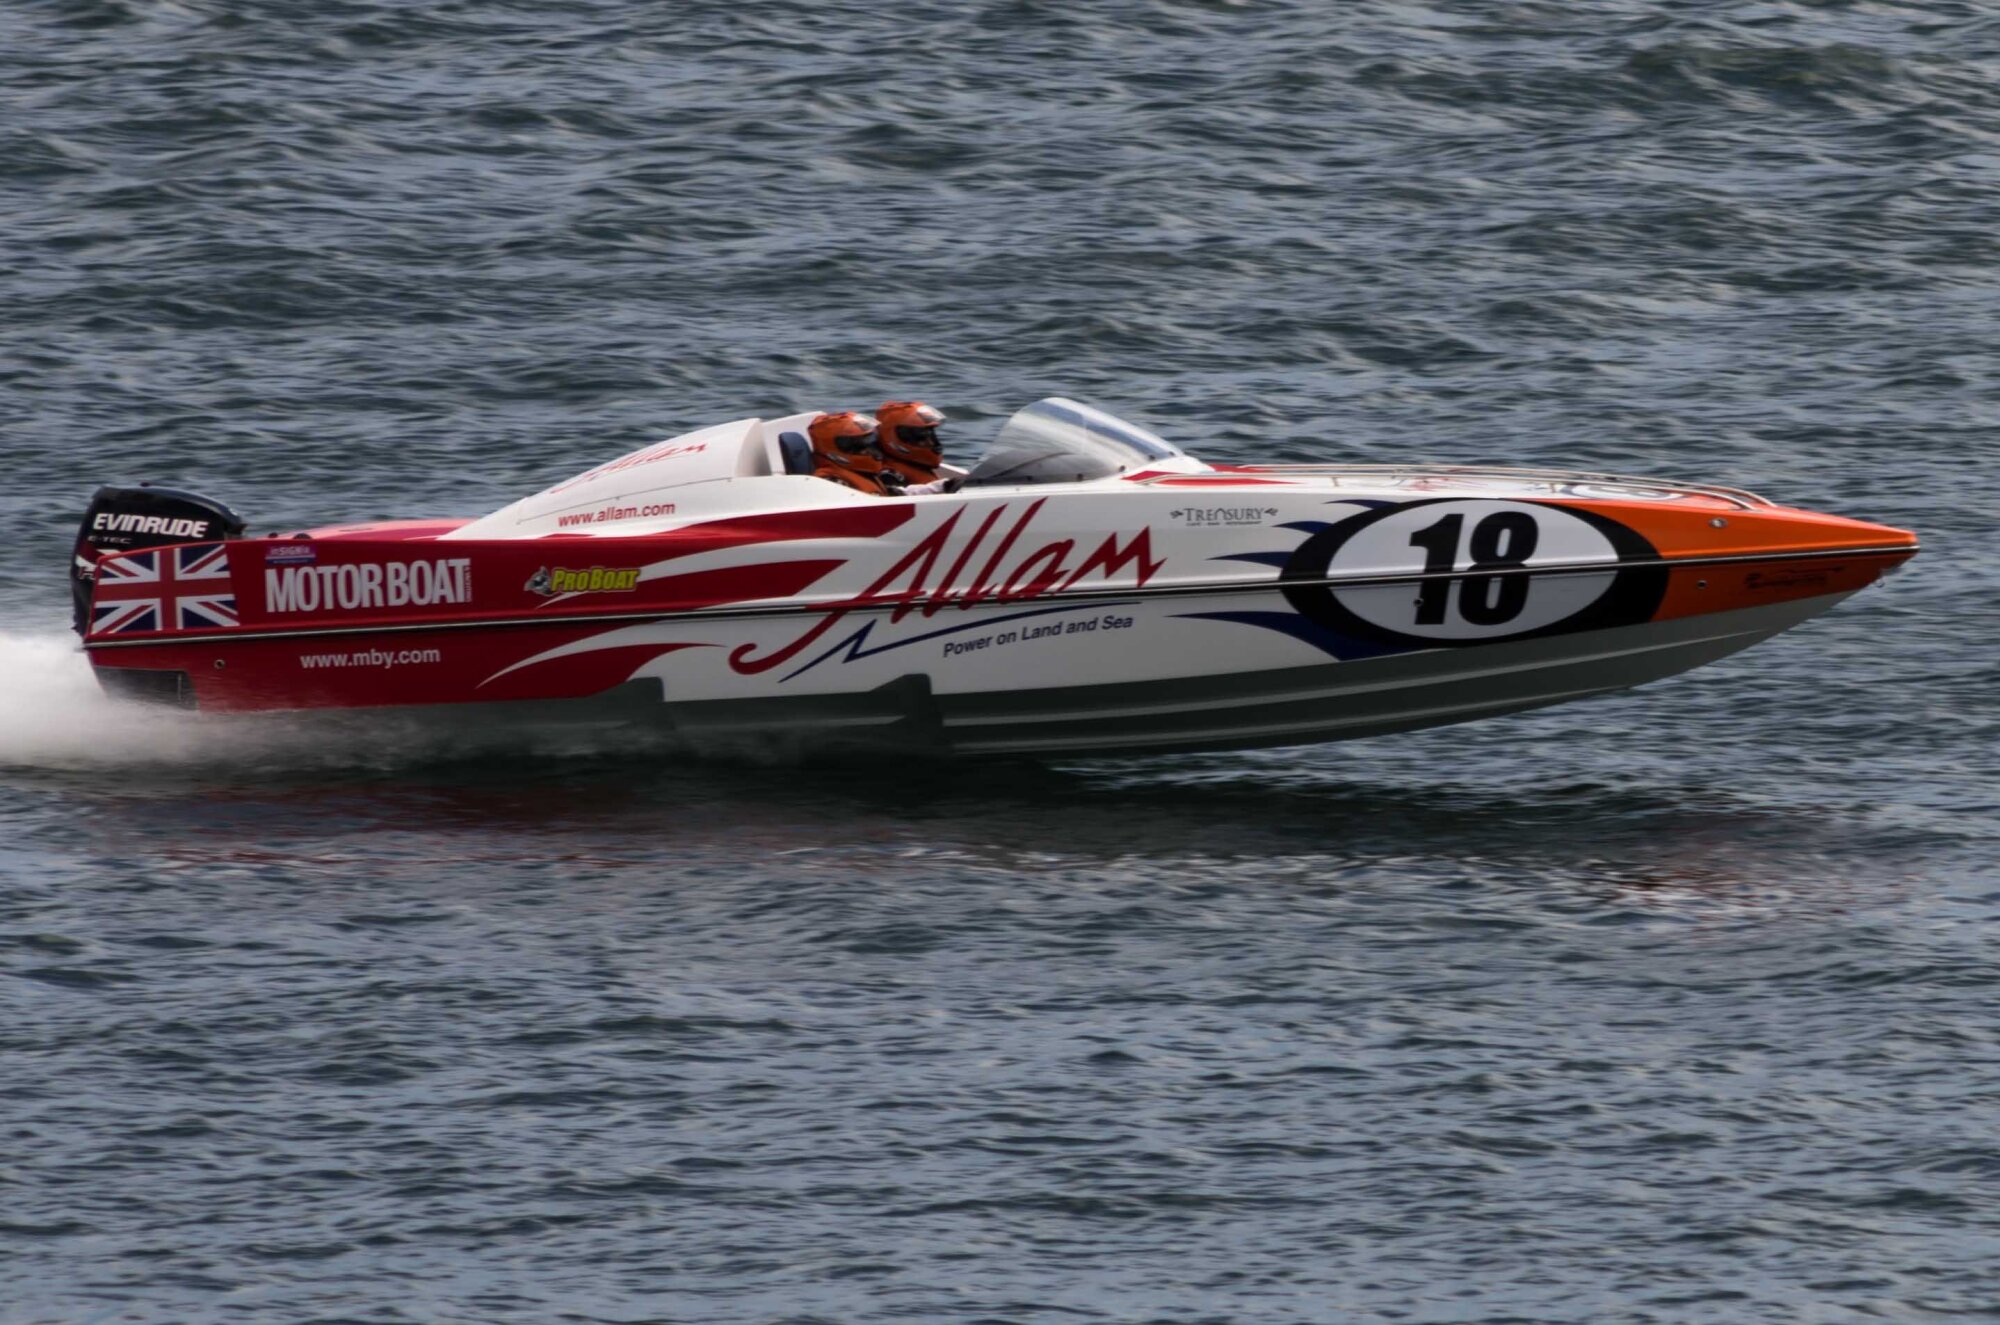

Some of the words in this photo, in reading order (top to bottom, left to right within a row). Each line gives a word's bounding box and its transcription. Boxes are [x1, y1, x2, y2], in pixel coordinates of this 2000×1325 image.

[93, 513, 209, 538] EVINRUDE
[558, 502, 676, 528] www.allam.com
[729, 496, 1168, 675] Allam
[1409, 510, 1539, 626] 18
[942, 634, 993, 658] Power
[996, 631, 1017, 646] on
[1021, 622, 1063, 641] Land
[1065, 617, 1099, 634] and
[1101, 614, 1134, 630] Sea
[300, 648, 441, 669] www.mby.com
